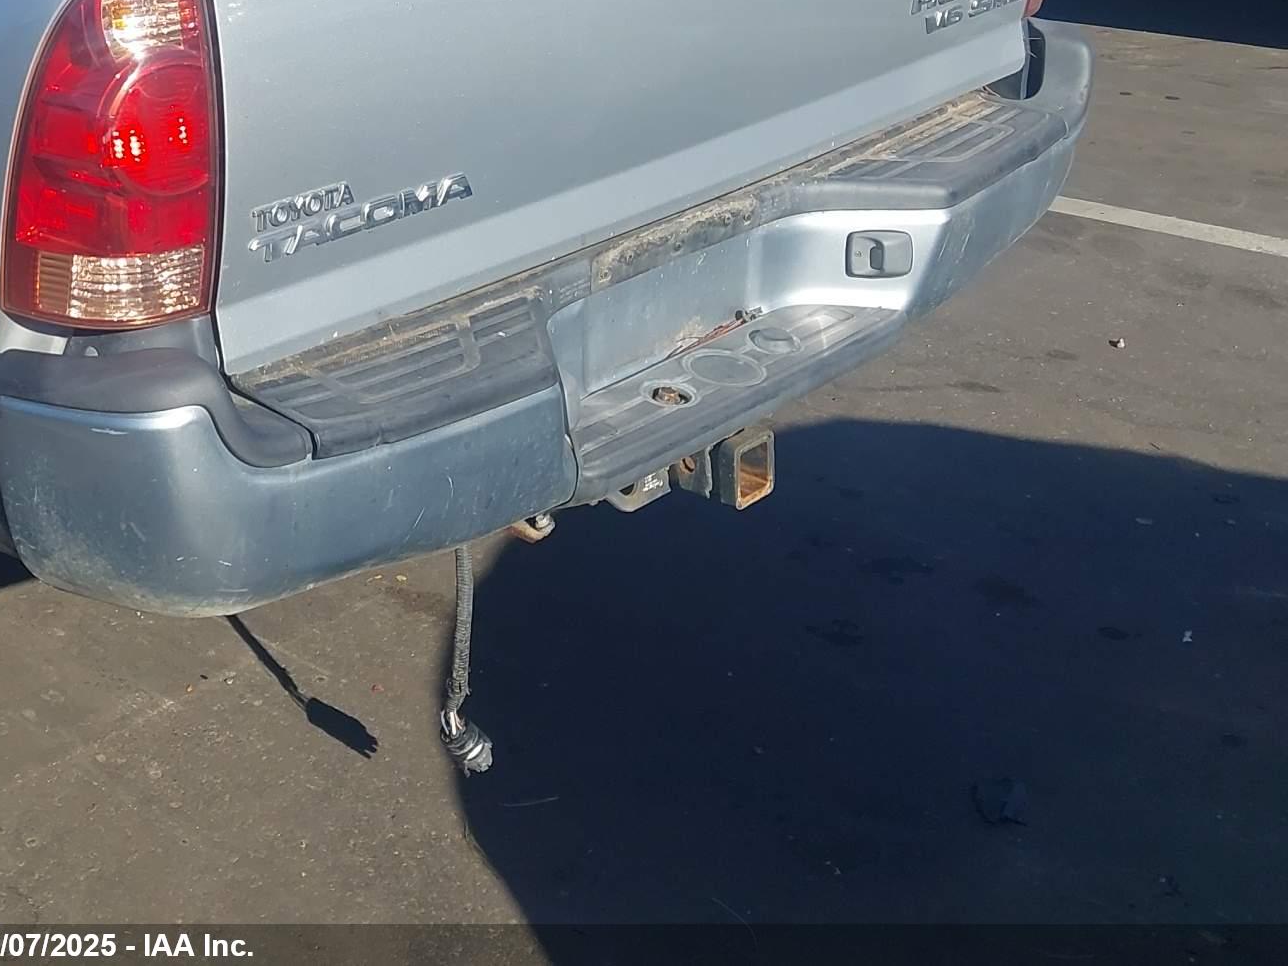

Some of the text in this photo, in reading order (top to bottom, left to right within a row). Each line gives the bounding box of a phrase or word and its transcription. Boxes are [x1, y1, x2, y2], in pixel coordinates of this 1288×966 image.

[924, 5, 964, 35] V6
[248, 172, 473, 263] TACOMA
[251, 181, 355, 232] TOYOTA
